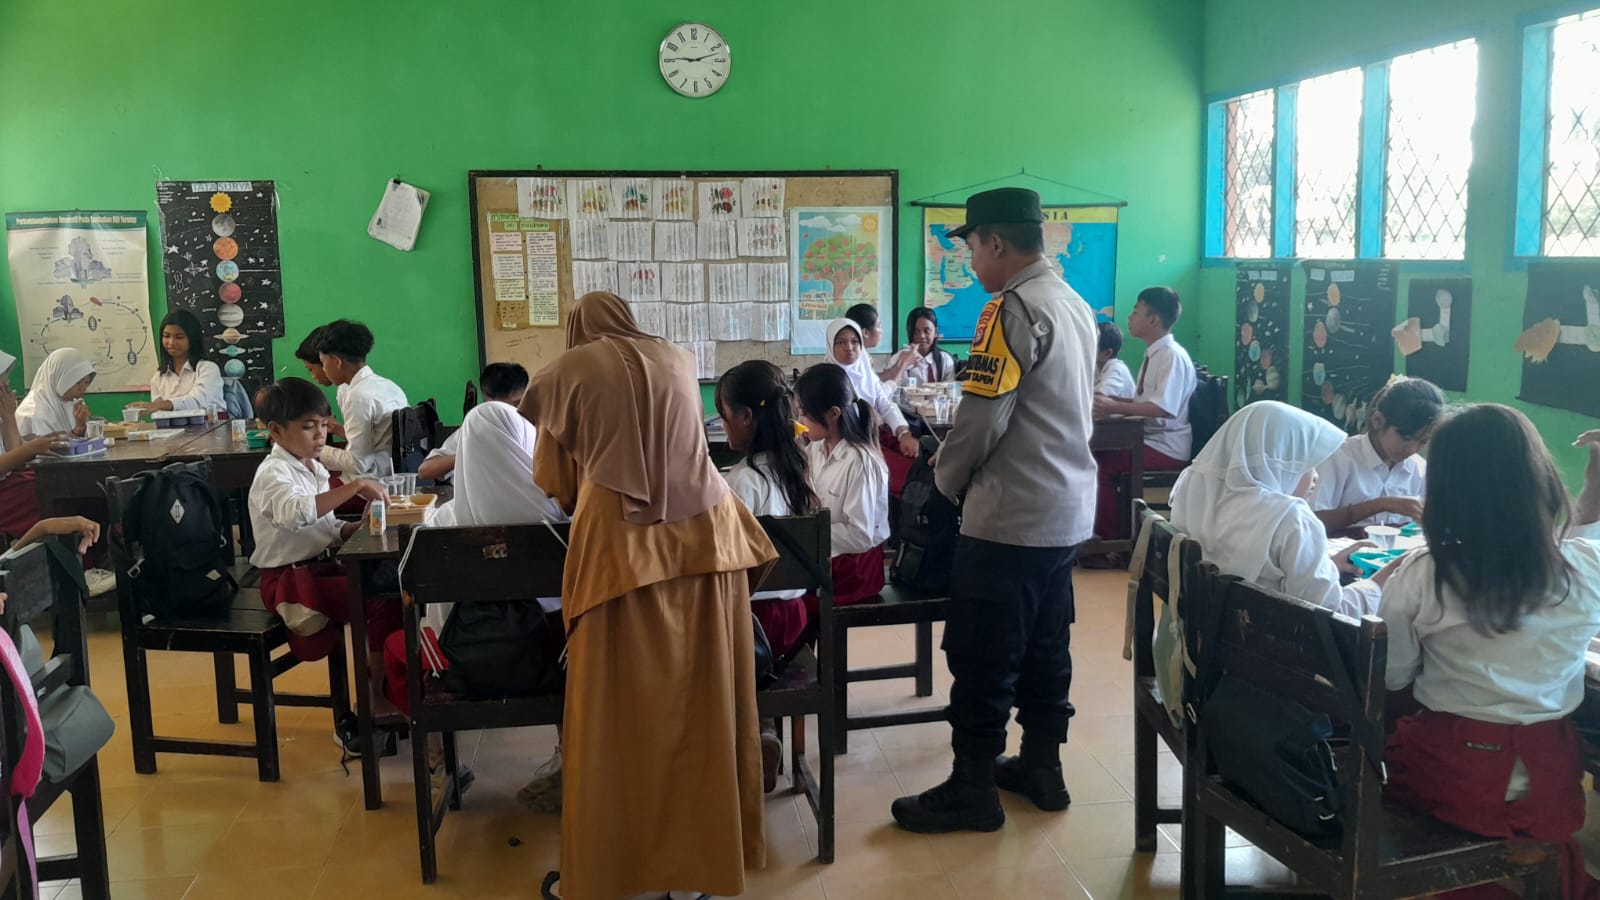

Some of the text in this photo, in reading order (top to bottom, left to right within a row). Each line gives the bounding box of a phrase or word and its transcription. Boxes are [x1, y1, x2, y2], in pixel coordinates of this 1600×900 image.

[690, 28, 697, 40] 12
[704, 33, 709, 43] 1
[666, 42, 678, 52] 10
[711, 43, 721, 51] 2
[712, 69, 722, 77] 4
[680, 78, 687, 88] 7
[693, 80, 698, 93] 6
[704, 77, 712, 88] 5
[193, 182, 251, 191] TATA SURYA
[1043, 210, 1069, 221] SIA
[971, 373, 994, 385] TAPEN
